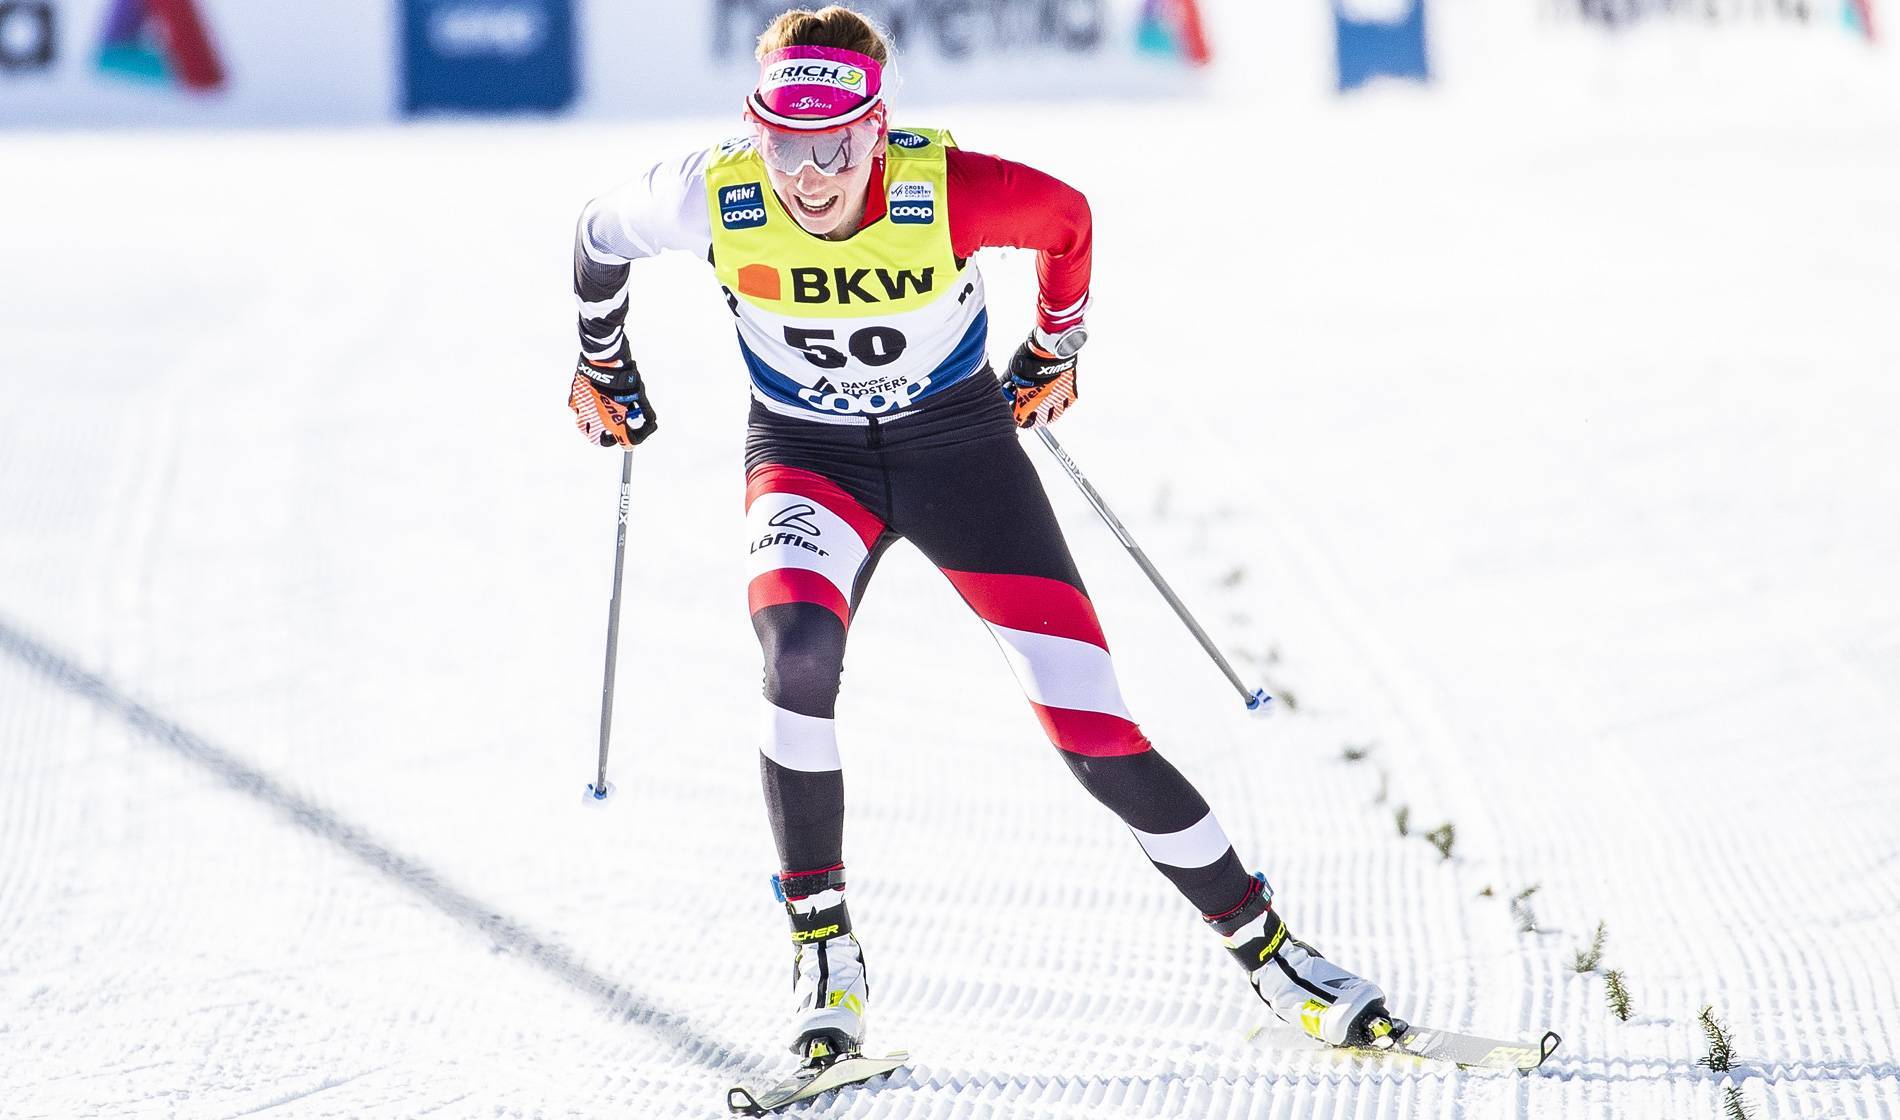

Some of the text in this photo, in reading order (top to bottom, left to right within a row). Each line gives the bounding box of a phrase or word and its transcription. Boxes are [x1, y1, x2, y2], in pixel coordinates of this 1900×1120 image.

[769, 66, 838, 81] ERICH
[780, 77, 838, 85] NATIONAL
[723, 208, 765, 223] coop
[892, 207, 933, 219] coop
[791, 267, 934, 304] BKW
[783, 325, 907, 369] 50
[843, 376, 907, 396] KLOSTERS
[750, 532, 830, 557] Löffler
